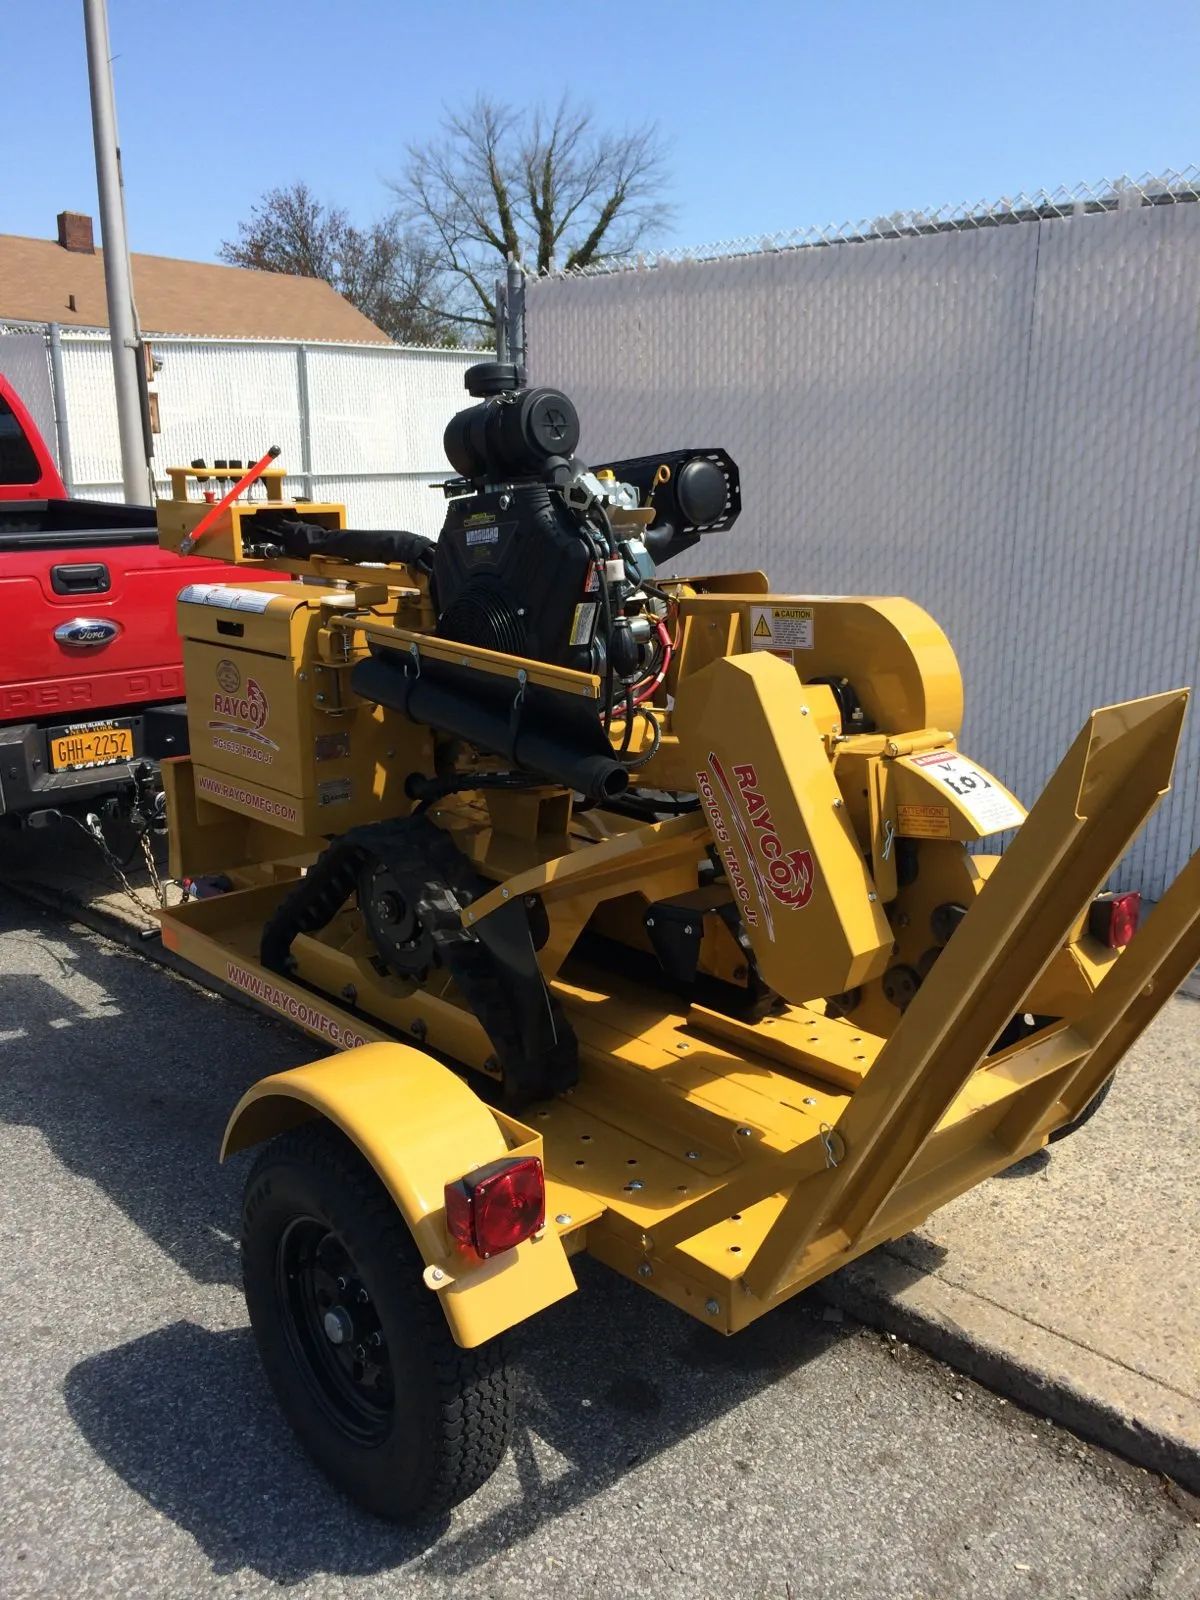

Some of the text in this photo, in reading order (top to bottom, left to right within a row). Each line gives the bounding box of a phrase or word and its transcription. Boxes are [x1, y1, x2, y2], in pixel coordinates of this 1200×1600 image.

[466, 527, 499, 542] VANGUARD
[781, 610, 811, 618] CAUTION
[78, 626, 105, 640] Ford
[0, 682, 93, 712] PER
[213, 693, 258, 723] RAYCO
[212, 736, 240, 755] RG1635
[241, 745, 263, 762] TRAC
[199, 776, 298, 823] WWW.RAYCOMFG.COM
[902, 806, 945, 816] ATTENTION!
[697, 772, 728, 842] RG1635
[723, 847, 751, 903] TRAC
[732, 763, 794, 888] RAYCO
